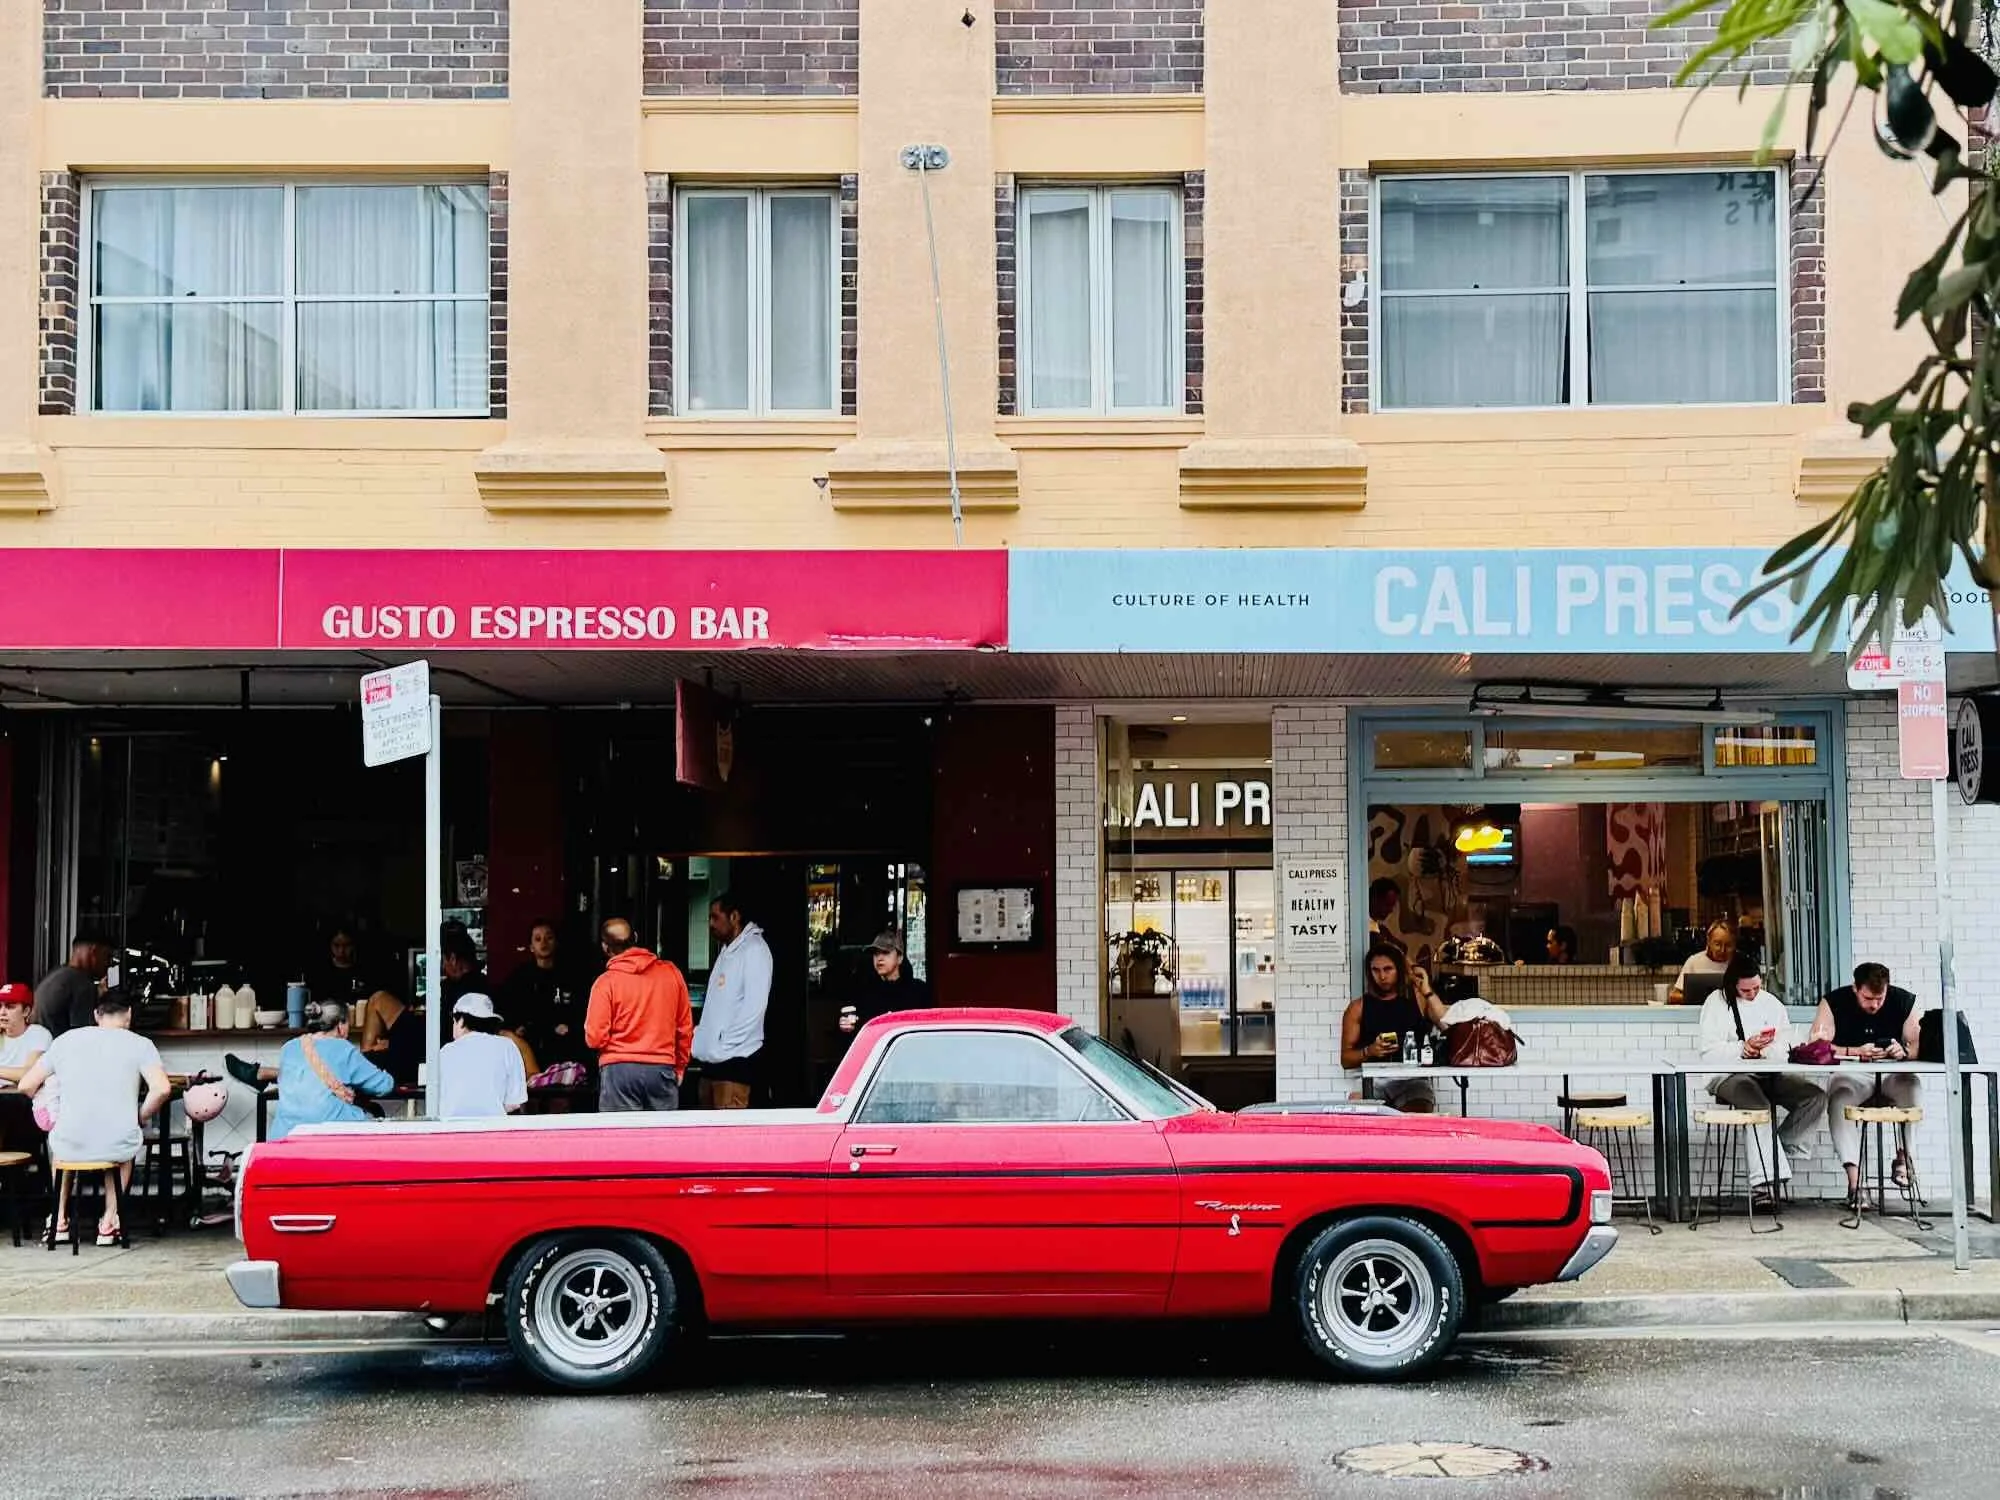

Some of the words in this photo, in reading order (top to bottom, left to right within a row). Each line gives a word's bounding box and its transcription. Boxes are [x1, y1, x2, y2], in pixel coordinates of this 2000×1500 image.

[1112, 594, 1195, 606] CULTURE
[1205, 594, 1228, 606] OF
[1238, 594, 1309, 606] HEALTH
[1376, 566, 1530, 636] CALI
[1557, 564, 1793, 636] PRESS
[322, 606, 456, 640] GUSTO
[470, 606, 676, 640] ESPRESSO
[690, 606, 769, 640] BAR
[1859, 659, 1885, 670] ZONE
[1913, 685, 1931, 700] NO
[1902, 703, 1945, 717] STOPPING
[1962, 723, 1976, 748] CALI
[1960, 747, 1979, 777] PRESS
[1288, 869, 1308, 879] CALI
[1309, 868, 1337, 879] PRESS
[1291, 898, 1336, 911] HEALTHY
[1289, 923, 1338, 936] TASTY
[1309, 1299, 1349, 1360] RADIAL
